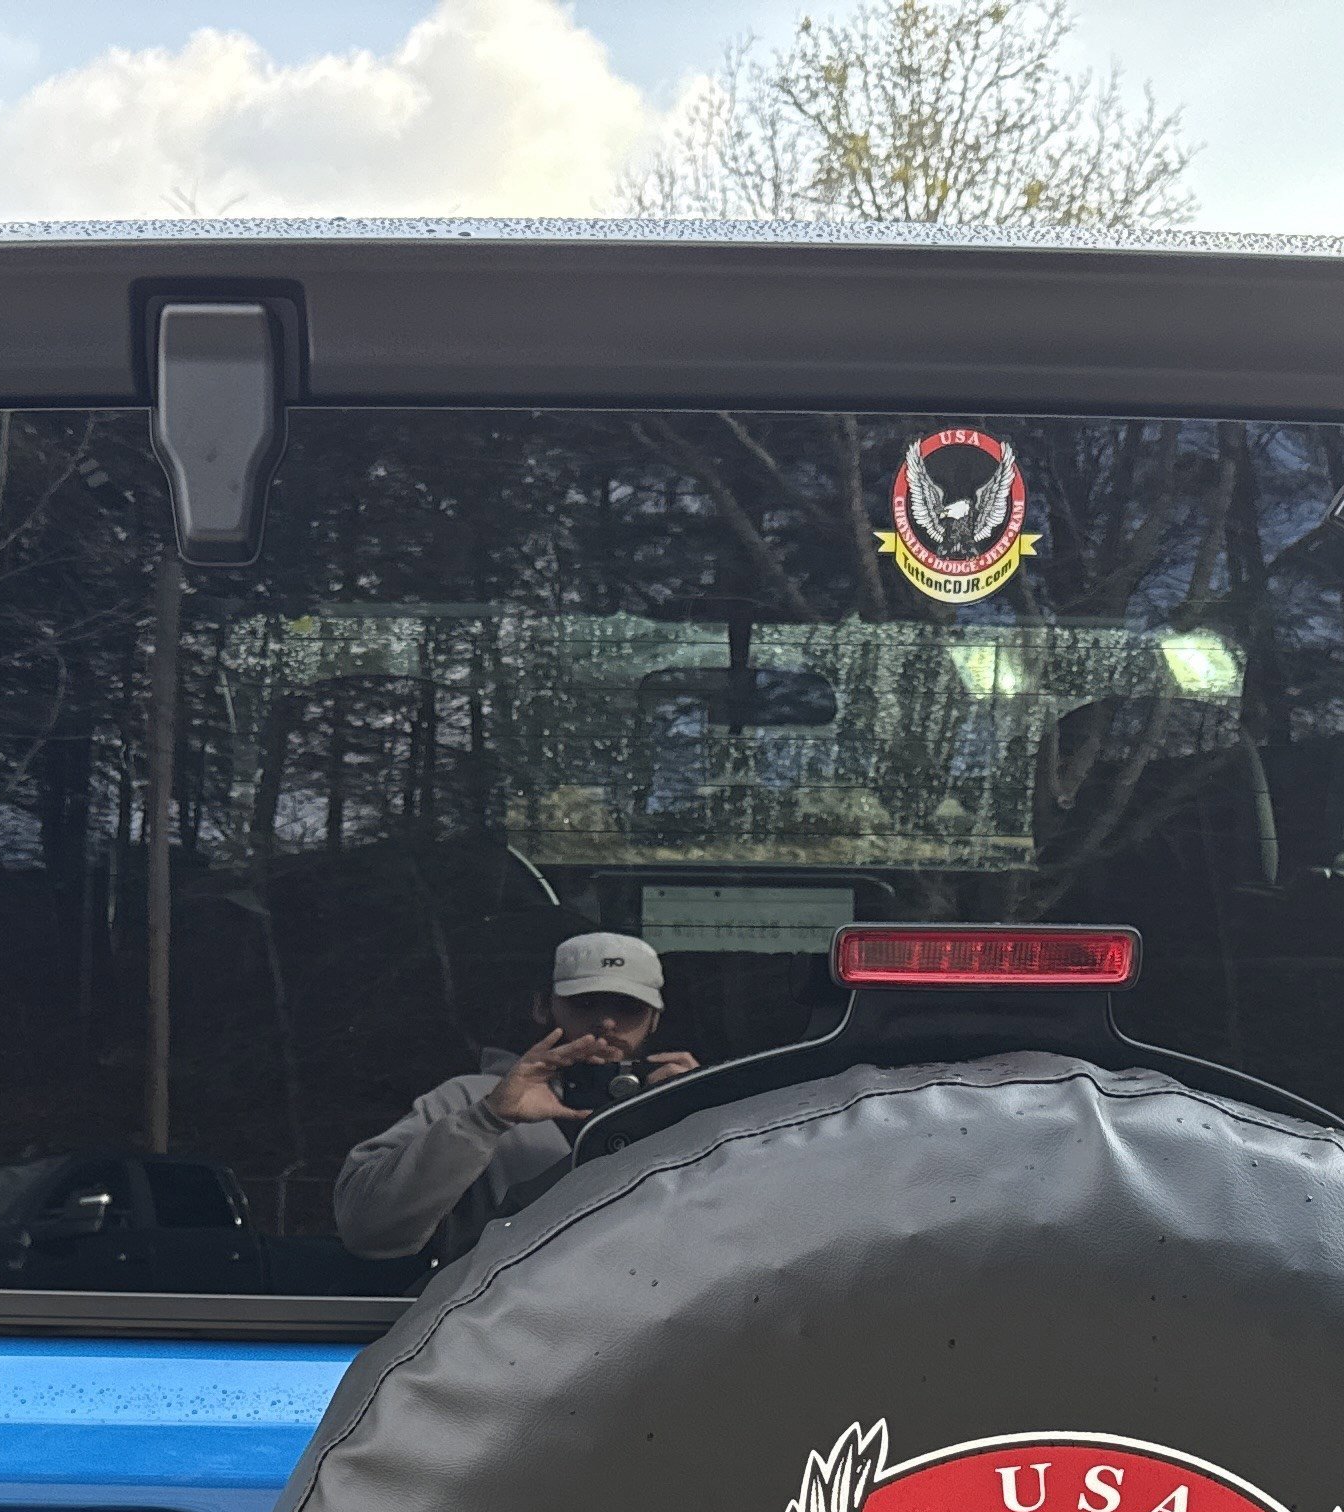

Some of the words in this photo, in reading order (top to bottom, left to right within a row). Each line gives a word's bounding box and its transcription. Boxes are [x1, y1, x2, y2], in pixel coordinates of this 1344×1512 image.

[938, 430, 981, 446] USA
[894, 496, 929, 563] CHRYSLER
[932, 560, 979, 574] DODGE
[985, 537, 1012, 565] JEEP
[1009, 500, 1025, 531] RAM
[902, 552, 1013, 595] TuttonCDJR.com
